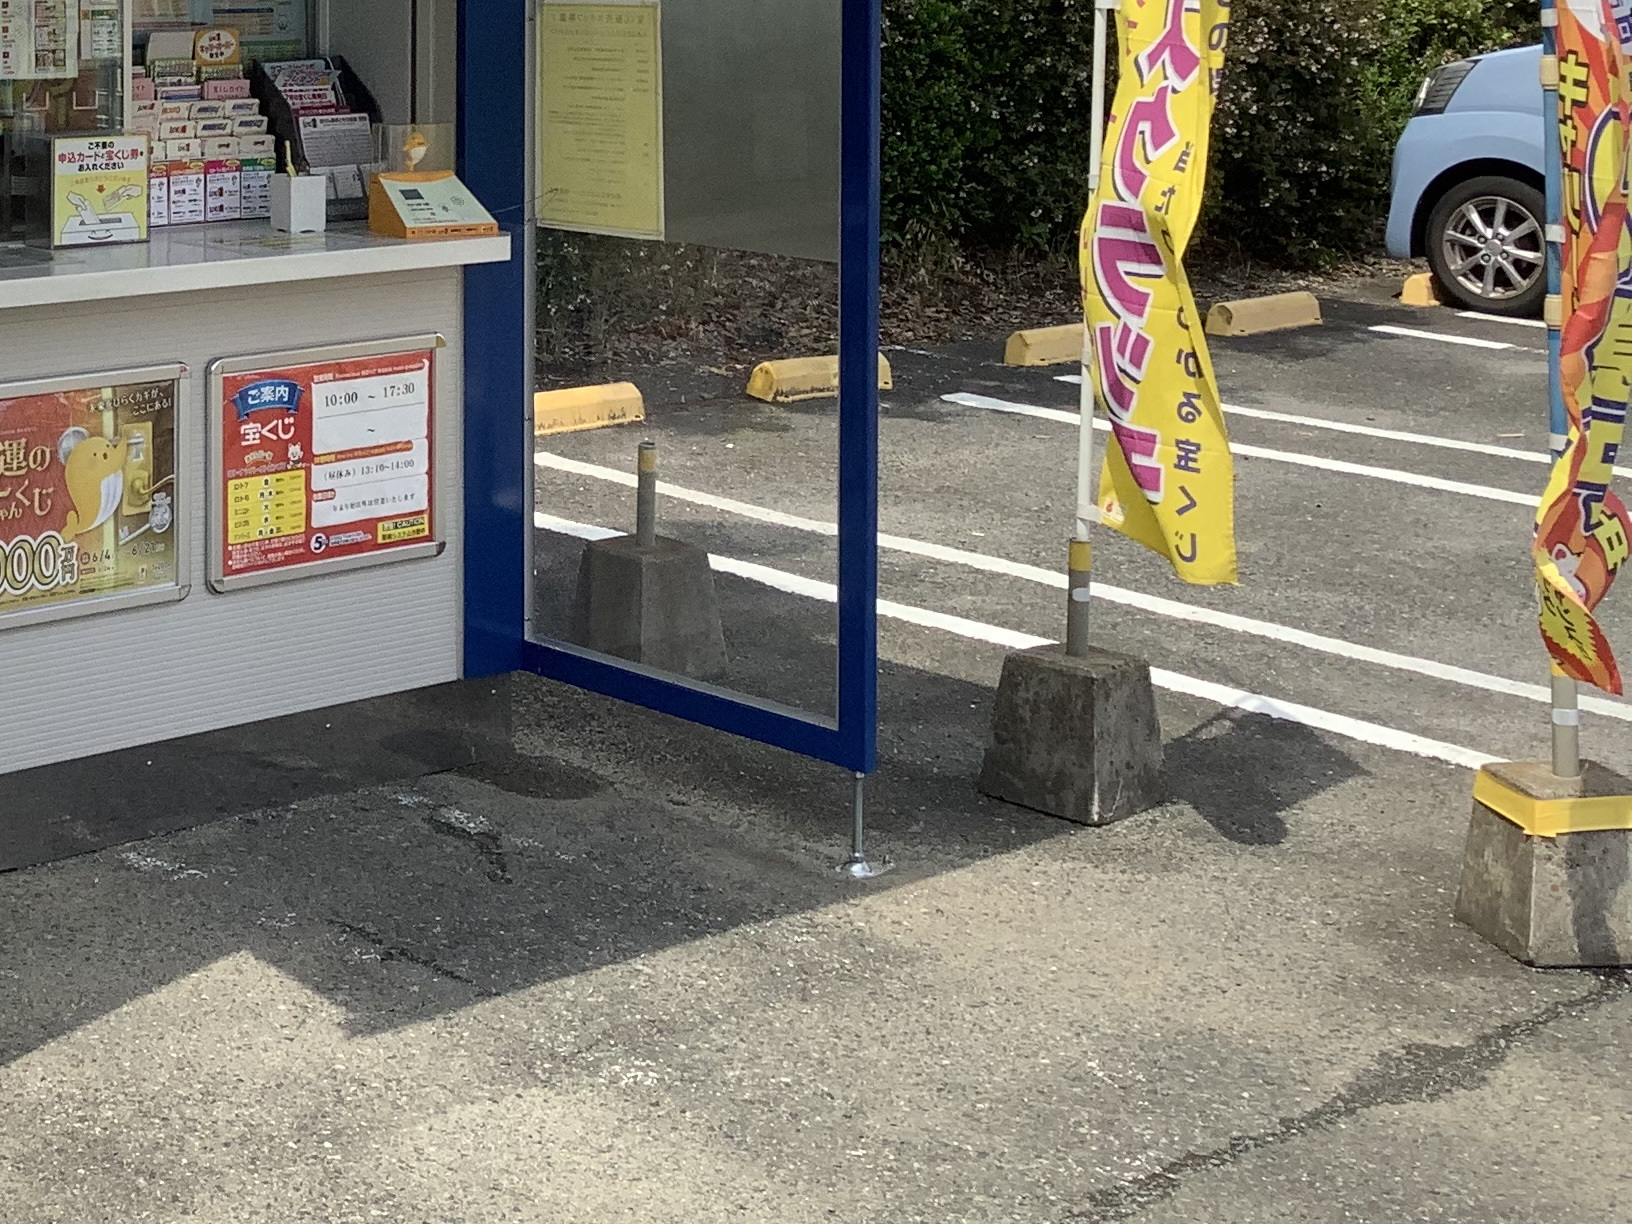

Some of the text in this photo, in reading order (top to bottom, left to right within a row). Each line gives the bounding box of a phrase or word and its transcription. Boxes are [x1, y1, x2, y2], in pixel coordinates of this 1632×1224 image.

[248, 384, 289, 405] ご案内
[325, 391, 359, 408] 10:00
[383, 382, 415, 399] 17:30
[240, 416, 295, 446] 宝くじ
